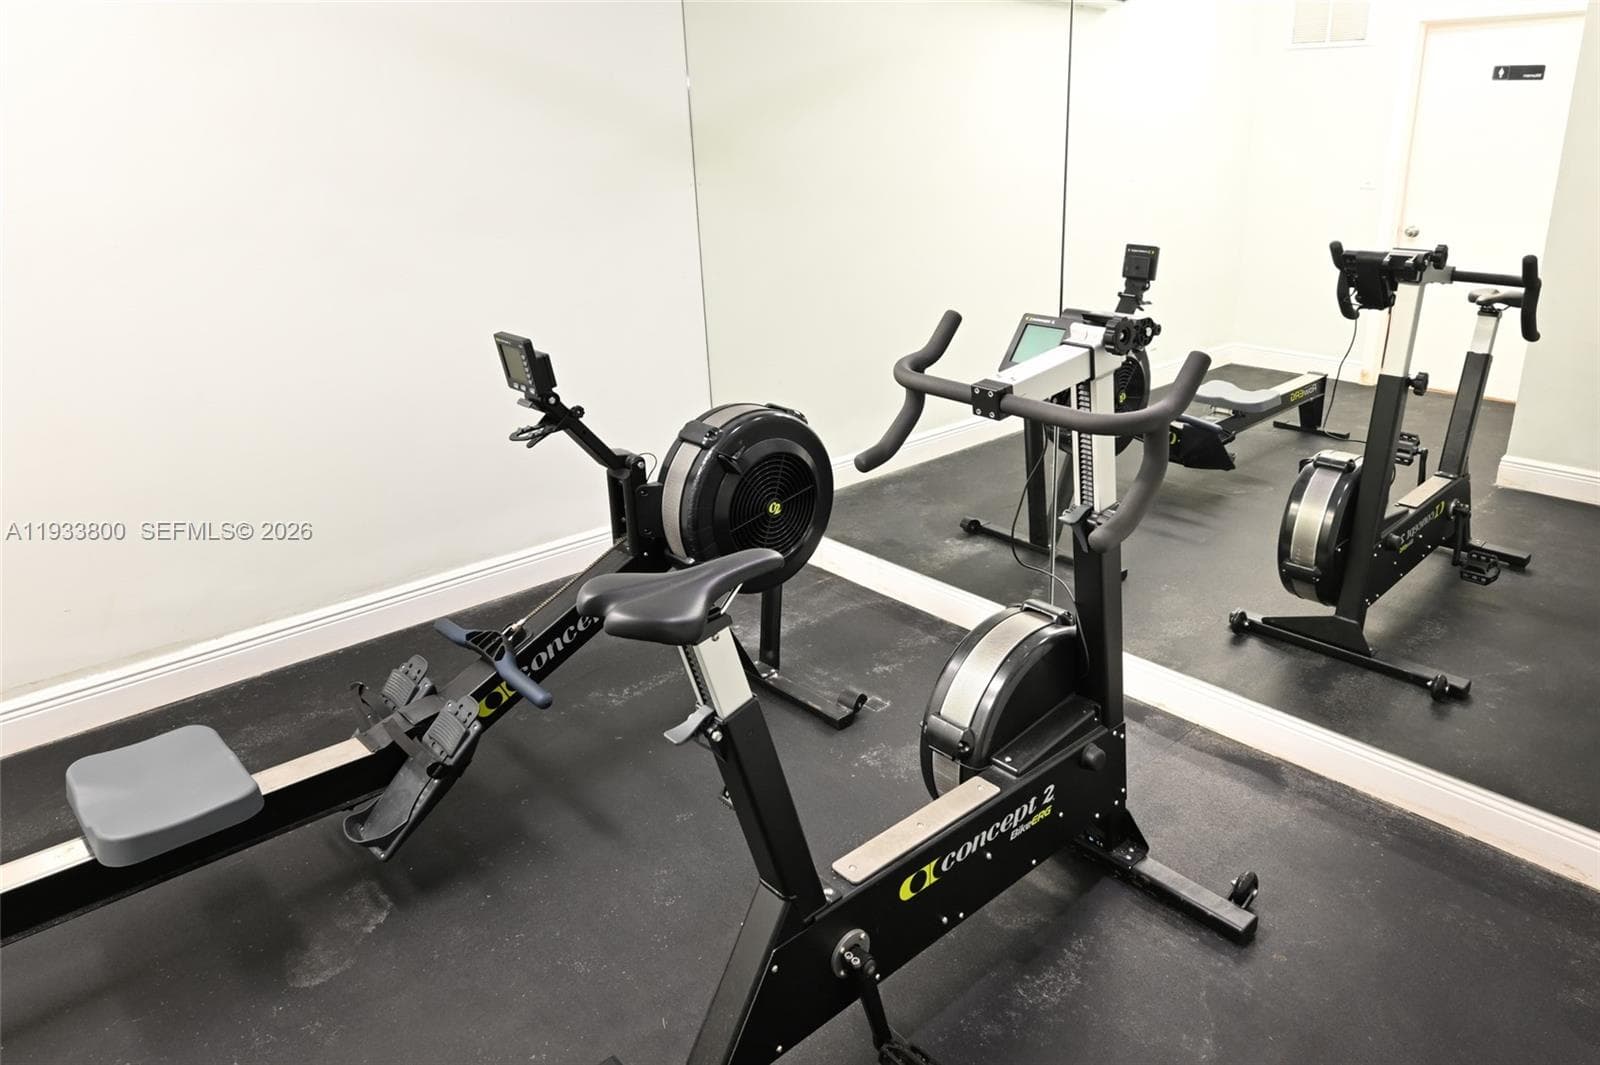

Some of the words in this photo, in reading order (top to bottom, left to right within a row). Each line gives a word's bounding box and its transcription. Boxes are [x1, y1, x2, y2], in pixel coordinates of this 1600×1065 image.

[521, 616, 600, 677] once
[940, 796, 1038, 872] concept
[1041, 784, 1056, 804] 2
